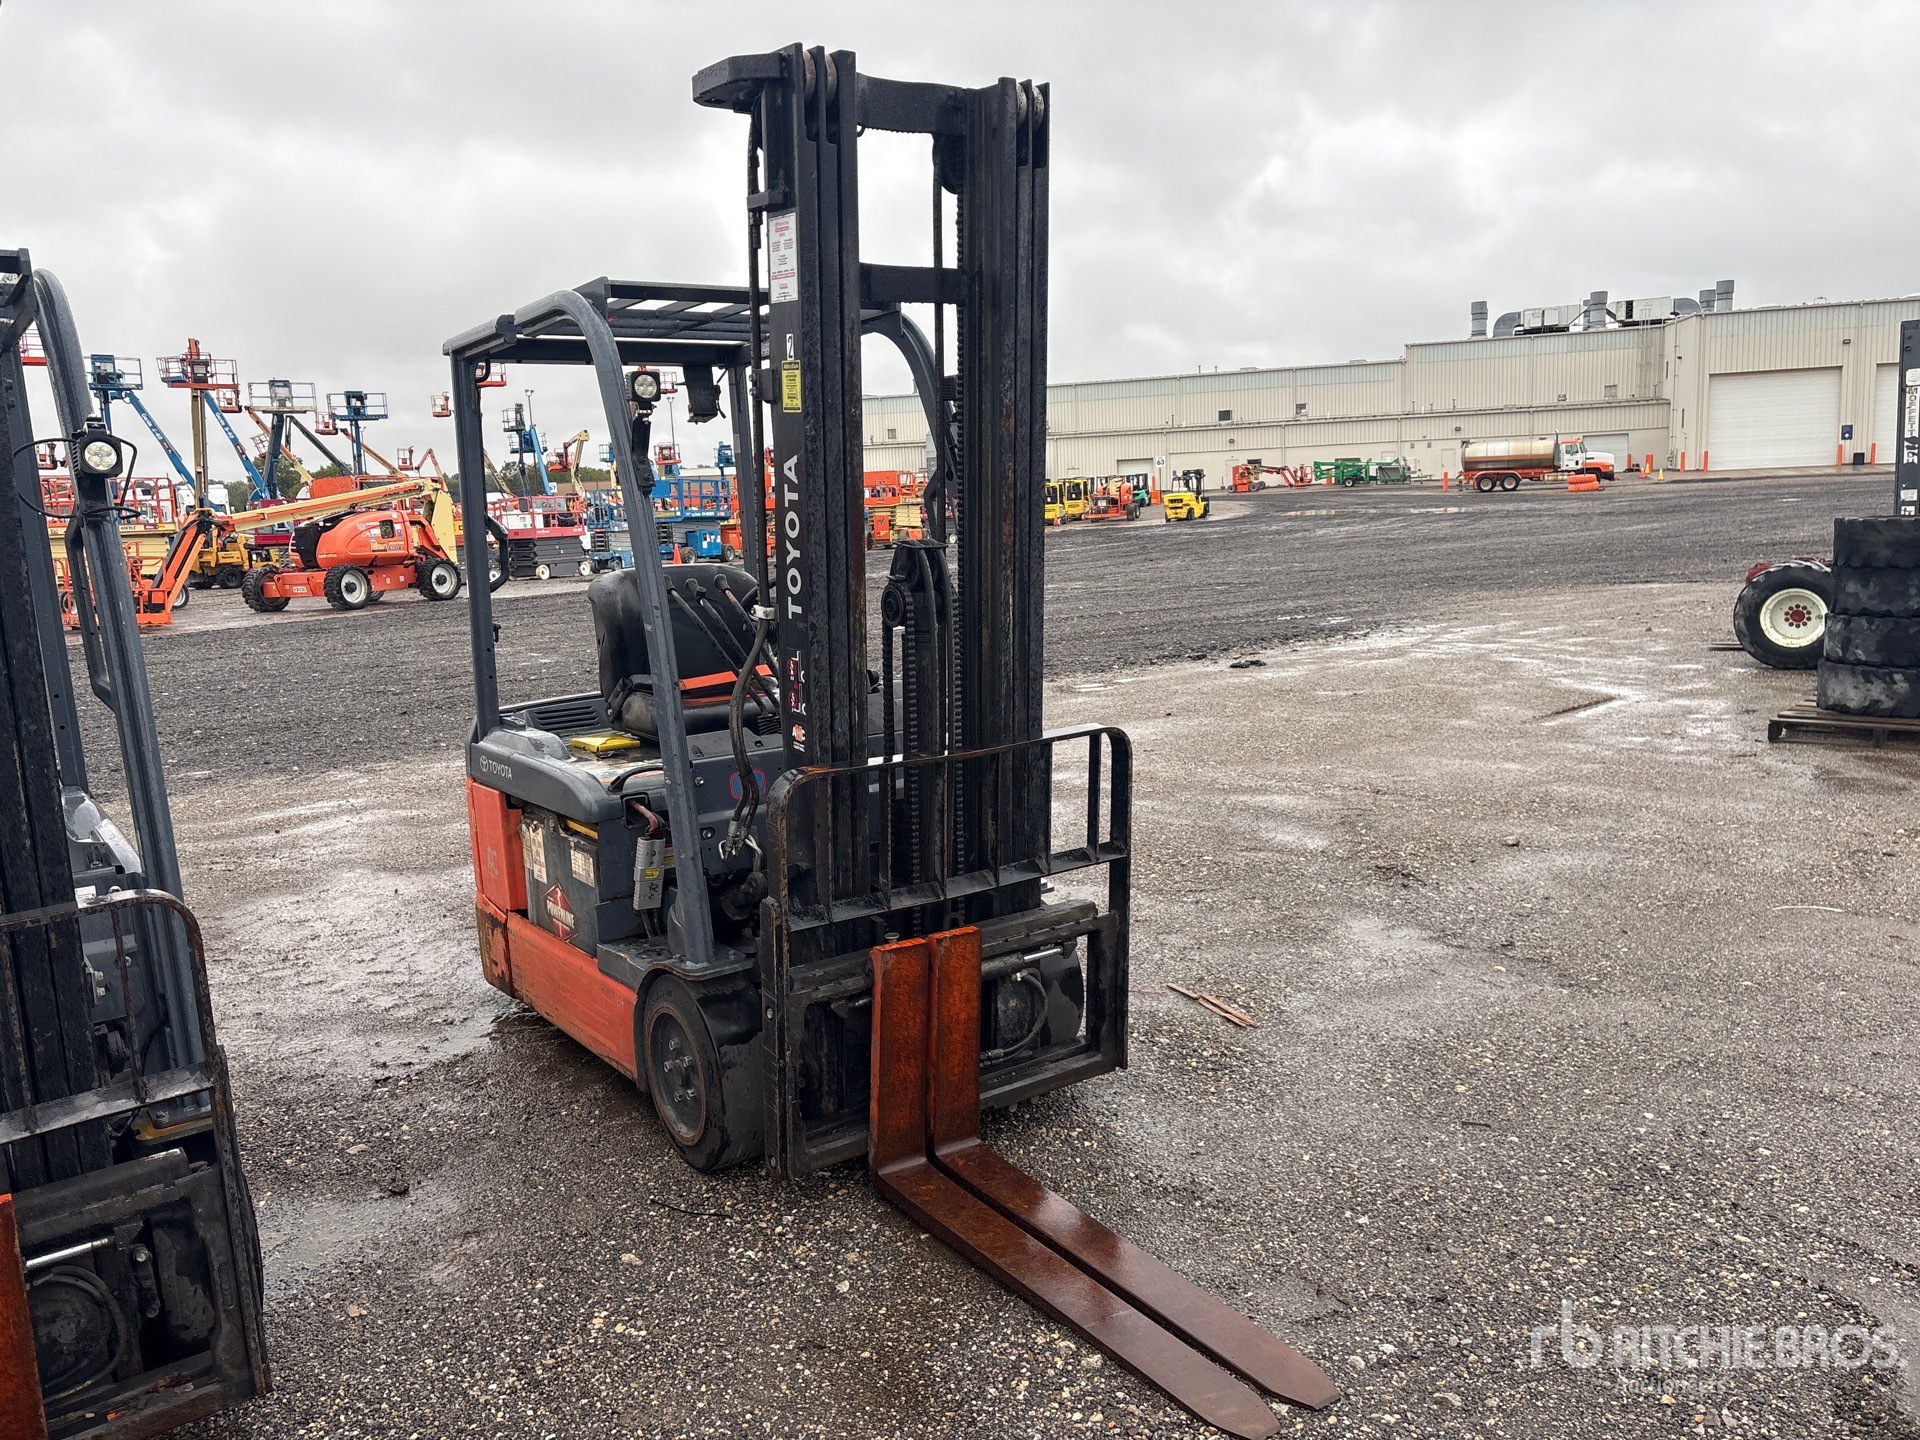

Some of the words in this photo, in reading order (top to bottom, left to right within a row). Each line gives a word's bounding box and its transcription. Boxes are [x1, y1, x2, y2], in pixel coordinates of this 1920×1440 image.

[787, 335, 793, 359] 2
[1156, 458, 1165, 466] 63
[783, 454, 804, 620] TOYOTA
[488, 760, 513, 780] TOYOTA
